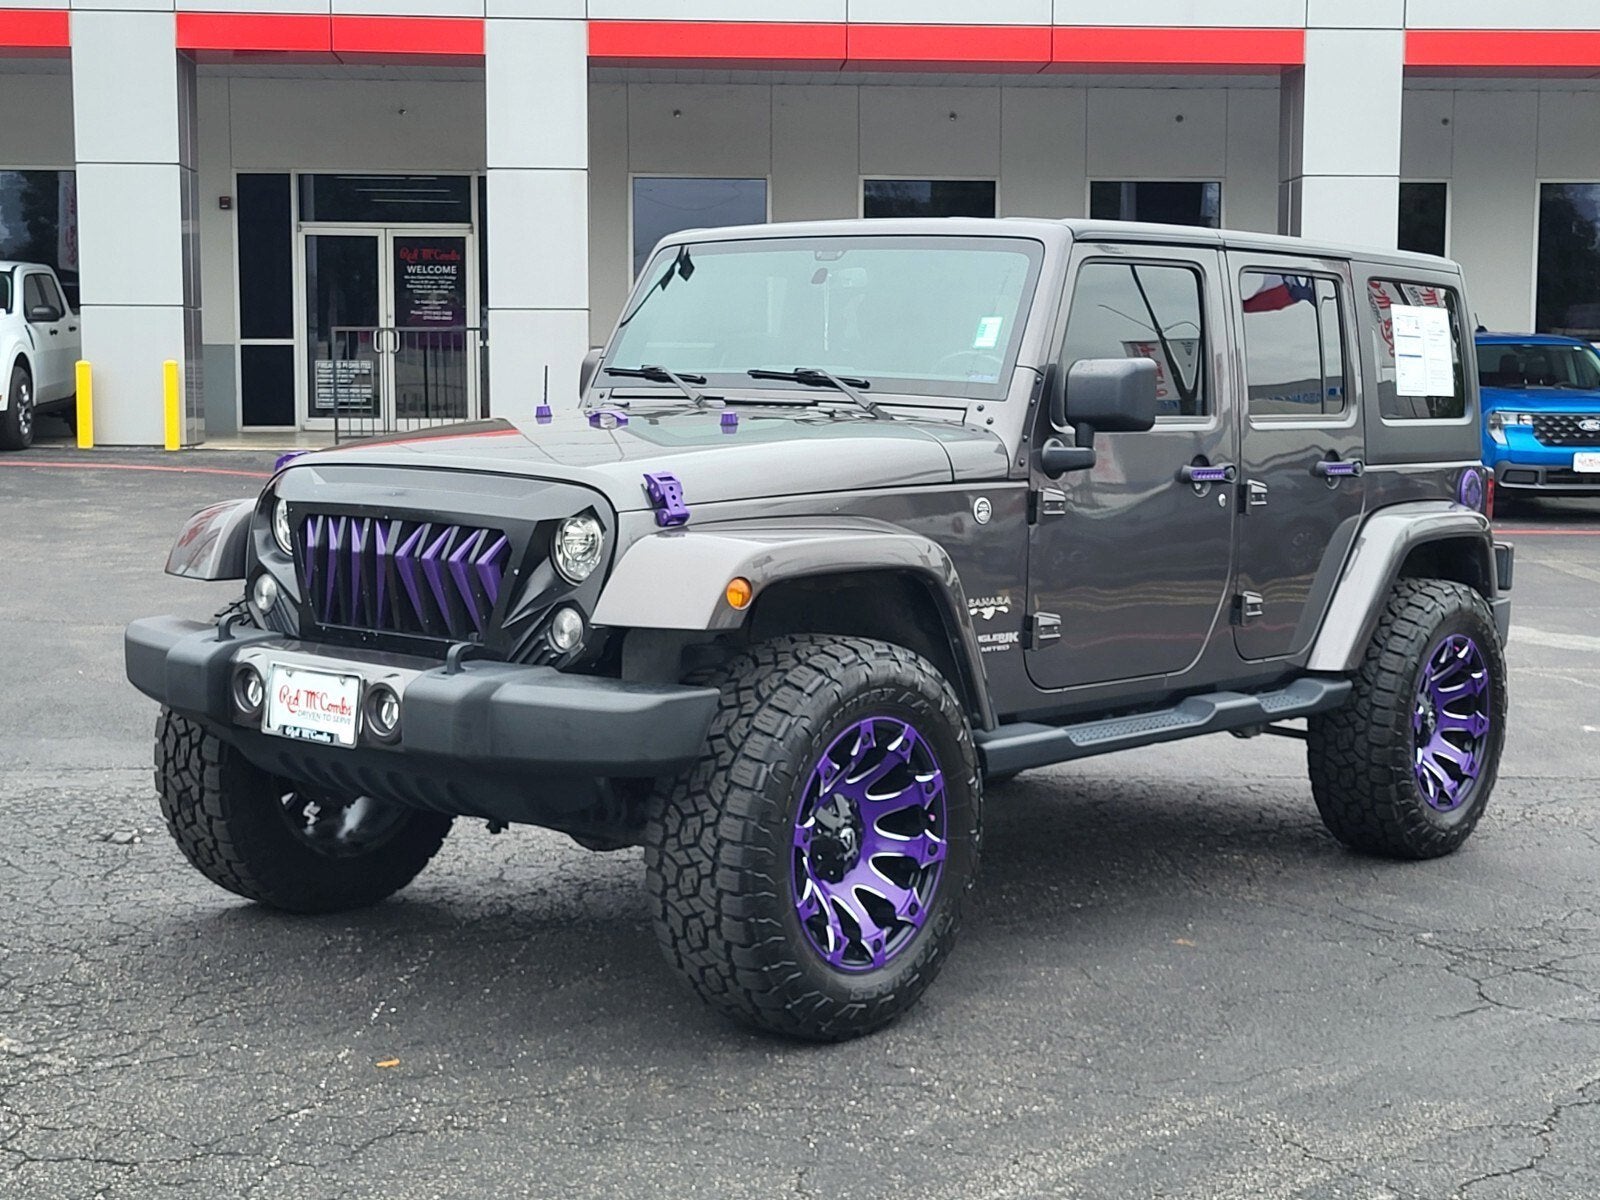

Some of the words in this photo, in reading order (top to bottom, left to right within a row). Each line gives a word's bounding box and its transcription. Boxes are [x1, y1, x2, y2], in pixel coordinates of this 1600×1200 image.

[406, 265, 457, 274] WELCOME
[279, 685, 300, 713] Red
[298, 709, 320, 721] DRIVEN
[323, 713, 332, 721] TO
